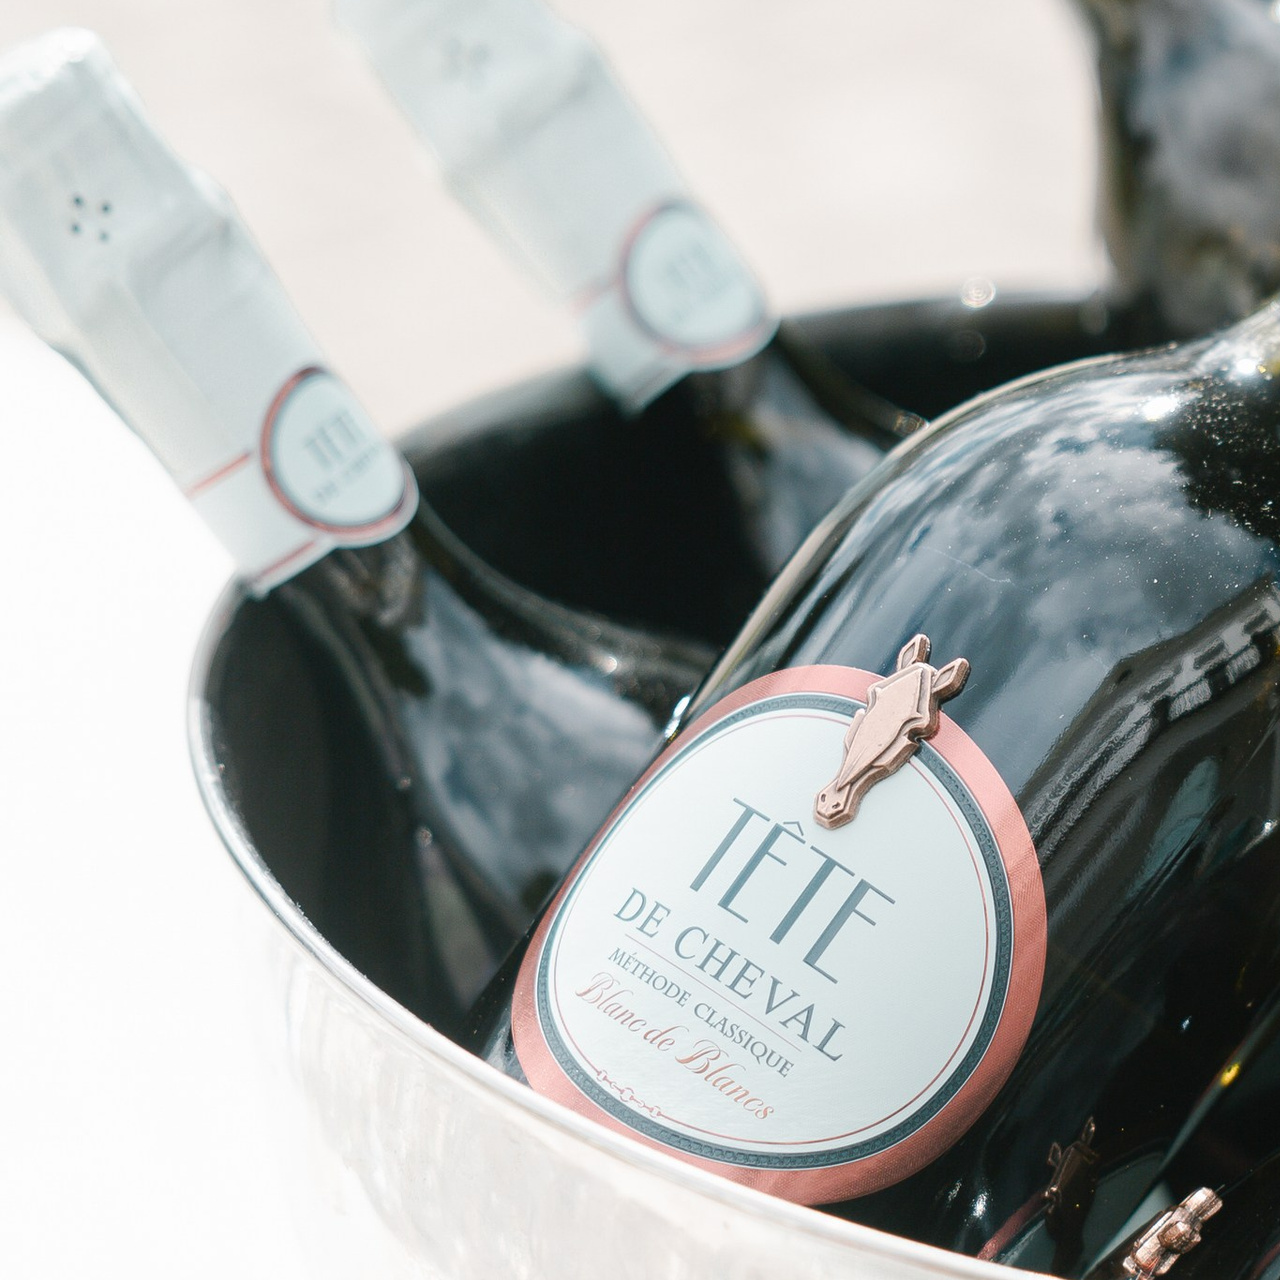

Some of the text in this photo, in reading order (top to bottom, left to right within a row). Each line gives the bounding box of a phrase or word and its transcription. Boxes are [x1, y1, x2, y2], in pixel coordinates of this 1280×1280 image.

[689, 797, 896, 984] TÊTE
[576, 971, 775, 1121] Blanc de Blancs
[608, 947, 795, 1078] MÉTHODE CLASSIQUE
[614, 887, 845, 1062] DE CHEVAL
